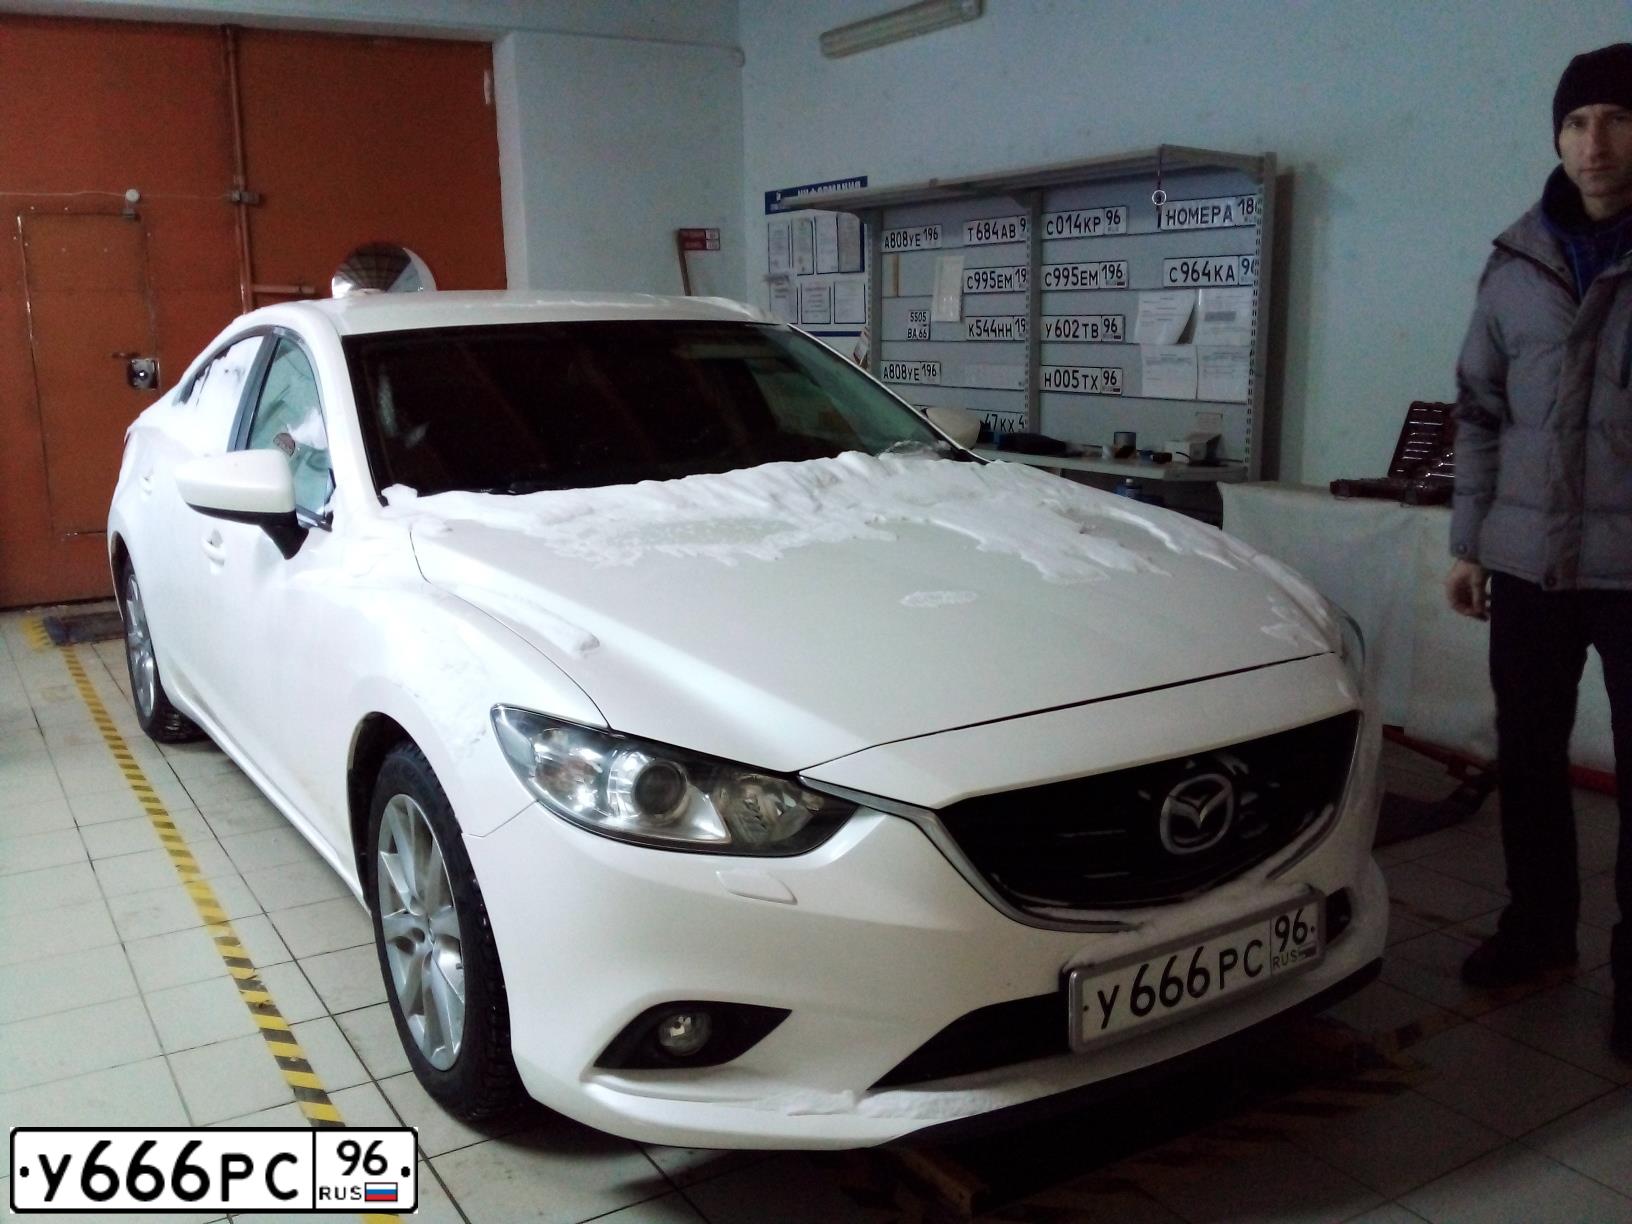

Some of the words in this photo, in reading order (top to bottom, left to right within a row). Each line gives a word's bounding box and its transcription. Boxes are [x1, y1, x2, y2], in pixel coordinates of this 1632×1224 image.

[1046, 213, 1101, 235] С014КР
[1106, 209, 1121, 226] 96
[1166, 204, 1233, 226] НОМЕРА
[1238, 197, 1256, 216] 18
[884, 231, 920, 249] А808УЕ
[923, 227, 938, 241] 196
[967, 221, 1016, 241] Т684АВ
[967, 270, 1014, 290] С995ЕМ
[1044, 266, 1098, 287] С995ЕМ
[1101, 263, 1123, 280] 196
[1169, 260, 1235, 283] С964КА
[1241, 258, 1255, 275] 9
[910, 311, 927, 322] 5505
[968, 319, 1013, 338] К544НН
[1045, 319, 1099, 339] У602ТВ
[1103, 317, 1118, 333] 96
[883, 363, 920, 381] А808УЕ
[921, 363, 937, 377] 196
[1044, 369, 1099, 390] Н005ТХ
[1103, 370, 1117, 386] 96
[1097, 939, 1263, 1029] У666РС
[1274, 908, 1308, 952] 96
[1272, 949, 1298, 970] RUS
